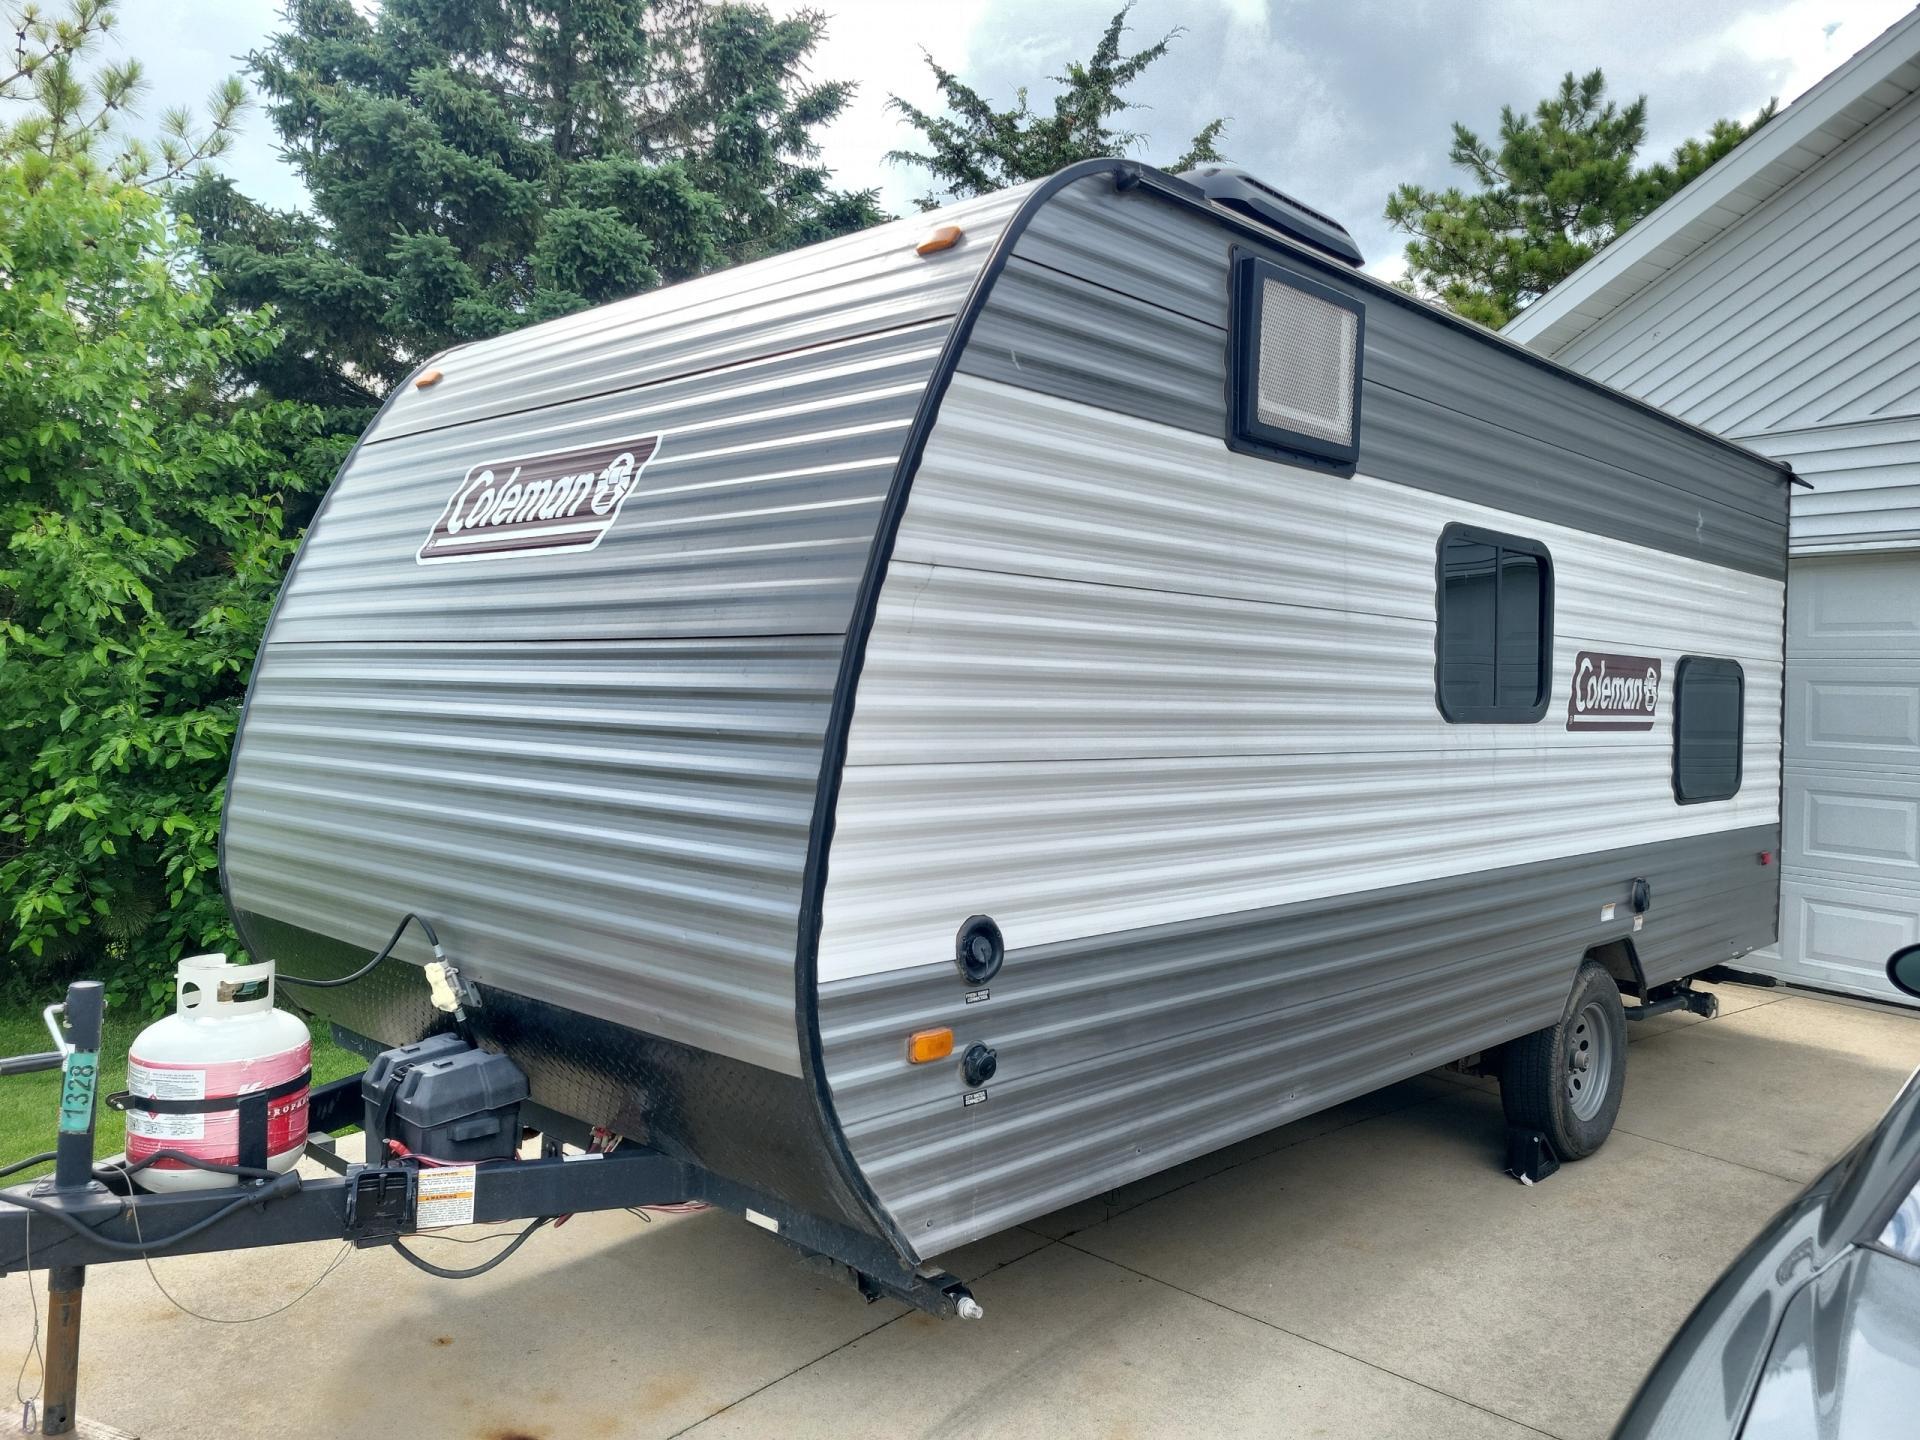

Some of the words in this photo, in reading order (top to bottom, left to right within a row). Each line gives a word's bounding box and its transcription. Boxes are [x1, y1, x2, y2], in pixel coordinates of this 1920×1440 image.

[447, 467, 595, 534] Coleman
[1575, 658, 1643, 712] Coleman
[63, 1065, 94, 1119] 1328
